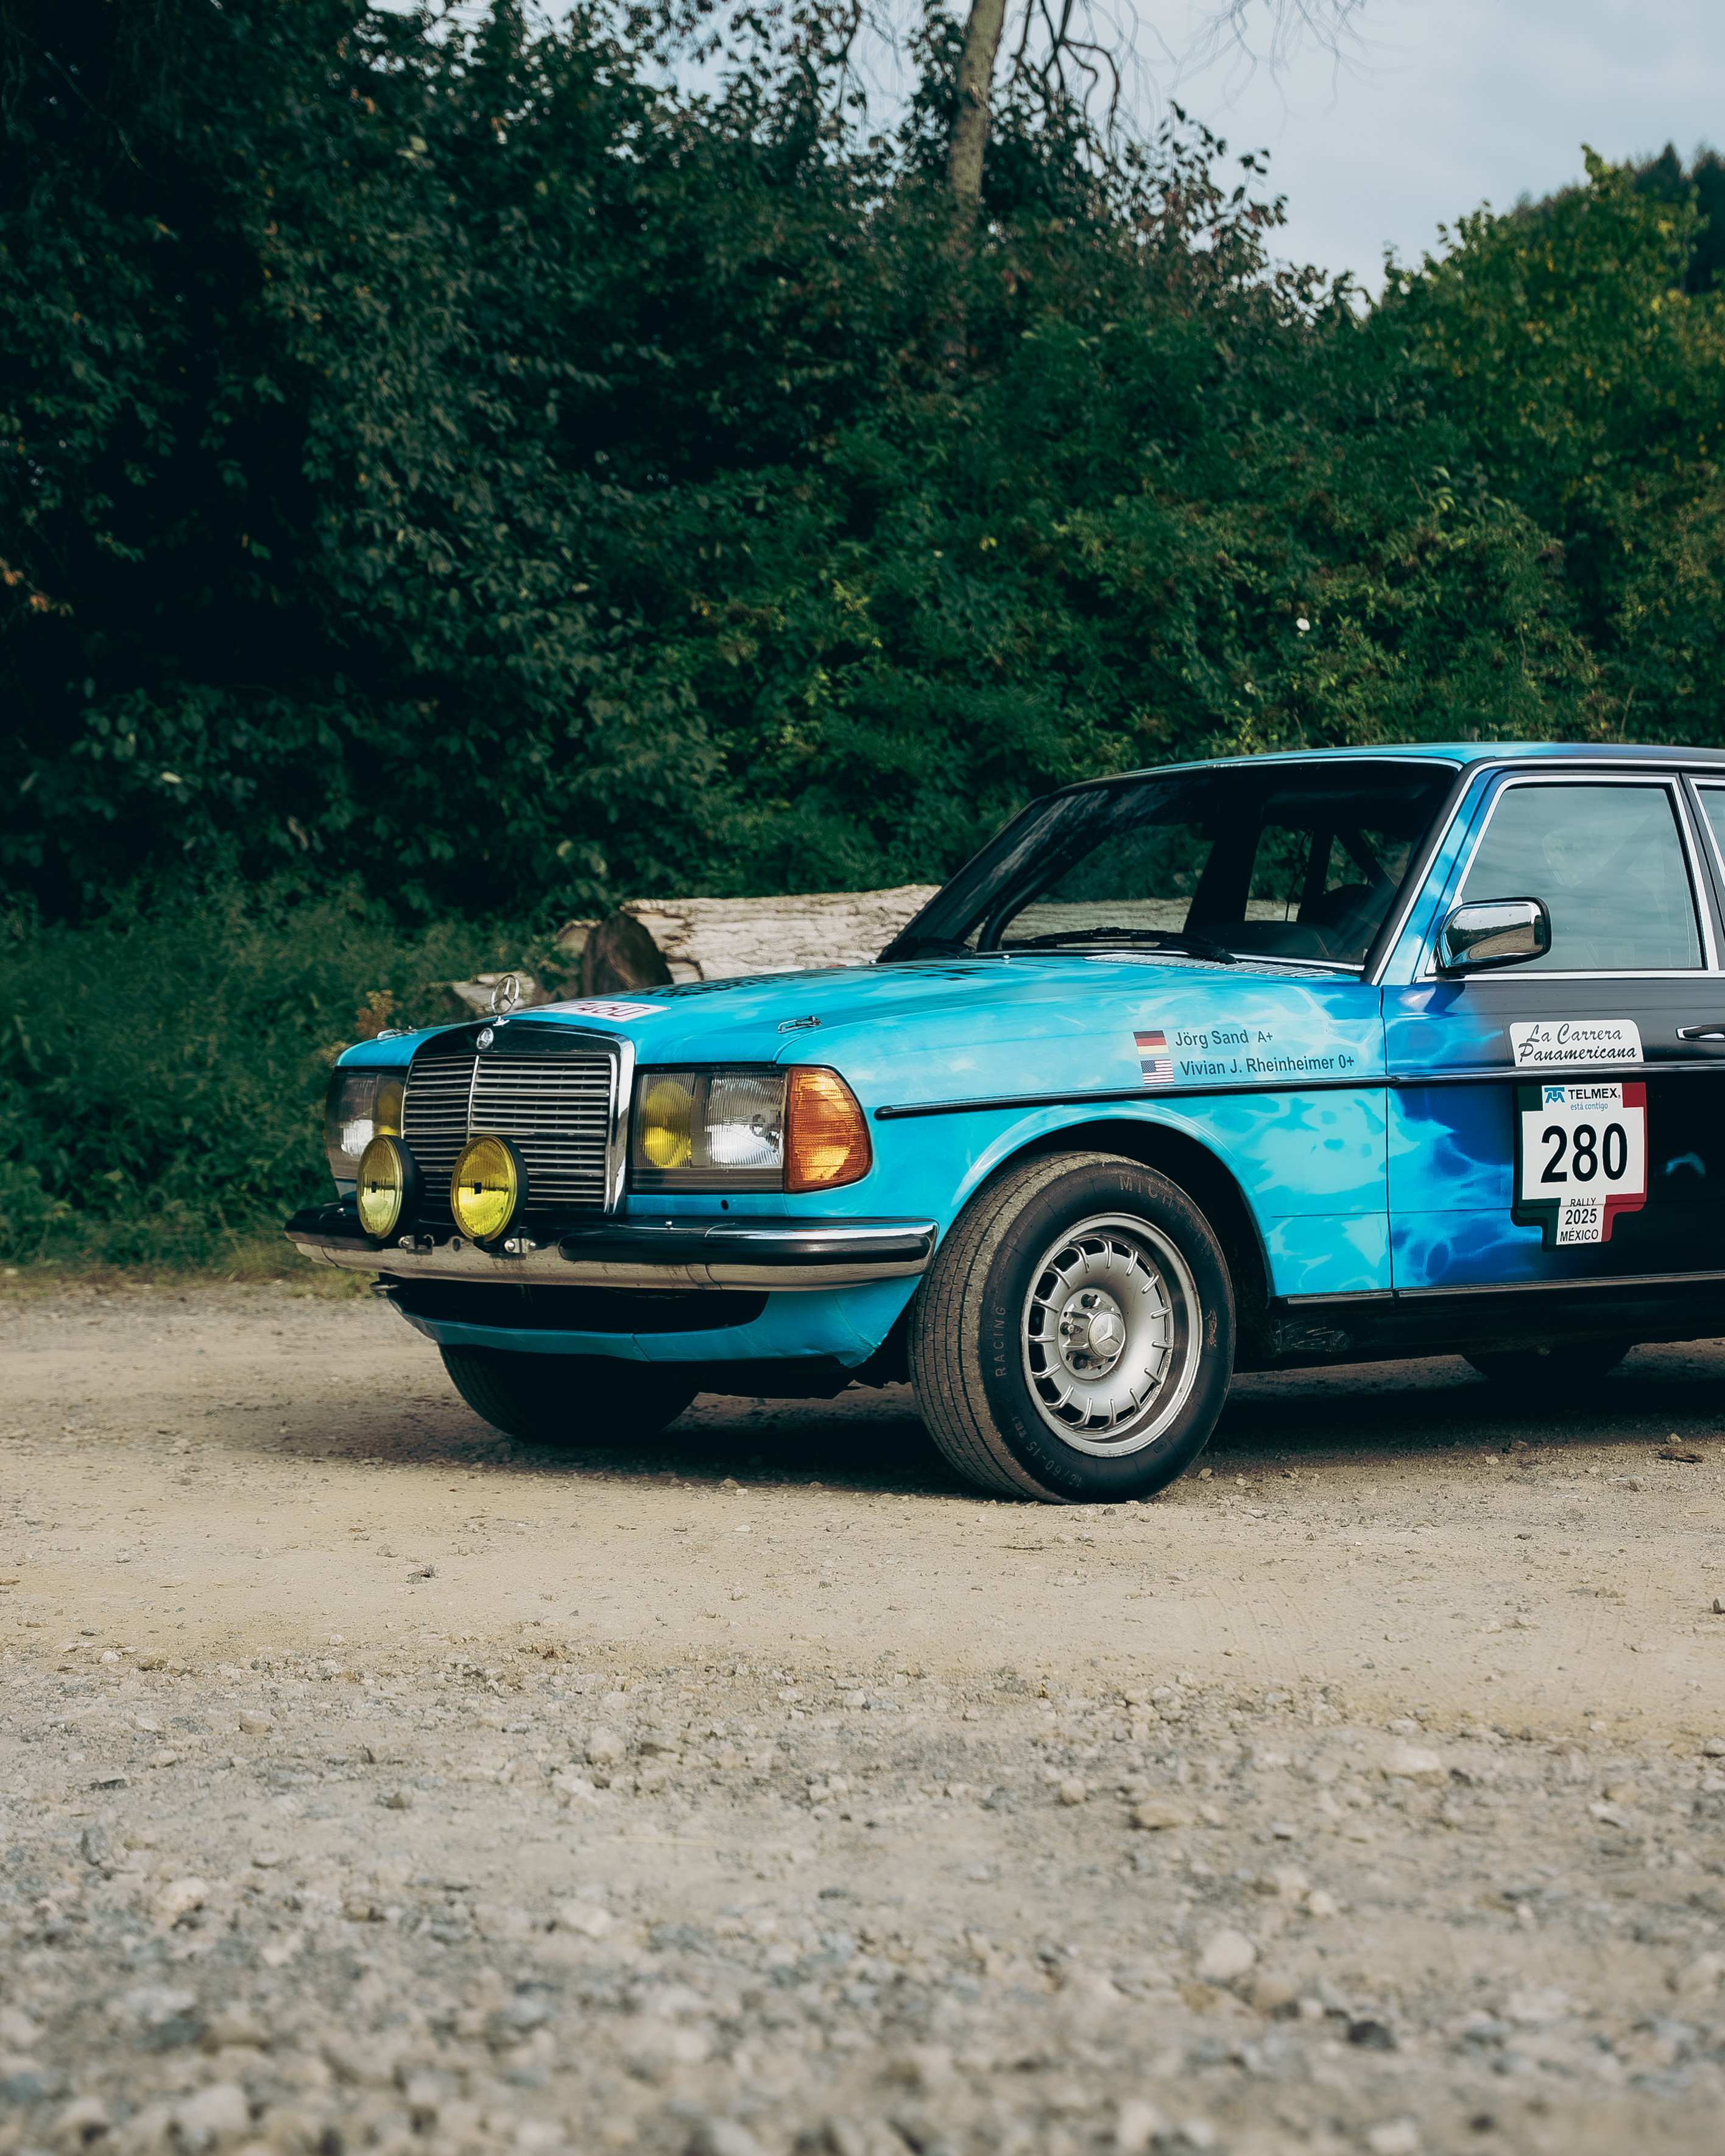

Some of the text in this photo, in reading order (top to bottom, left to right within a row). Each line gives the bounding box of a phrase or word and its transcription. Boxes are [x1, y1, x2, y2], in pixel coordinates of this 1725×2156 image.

[1175, 1029, 1273, 1049] Jörg Sand A+
[1526, 1023, 1623, 1045] La Carrera
[1519, 1042, 1637, 1063] Panamericana
[1180, 1060, 1226, 1076] Vivian
[1230, 1059, 1243, 1074] J.
[1246, 1055, 1335, 1073] Rheinheimer
[1567, 1088, 1618, 1100] TELMEX
[1570, 1102, 1609, 1112] está contigo
[1540, 1122, 1628, 1183] 280
[1570, 1197, 1596, 1207] RALLY
[1565, 1208, 1597, 1225] 2025
[1560, 1227, 1599, 1242] MÉXICO
[993, 1306, 1007, 1378] RACING
